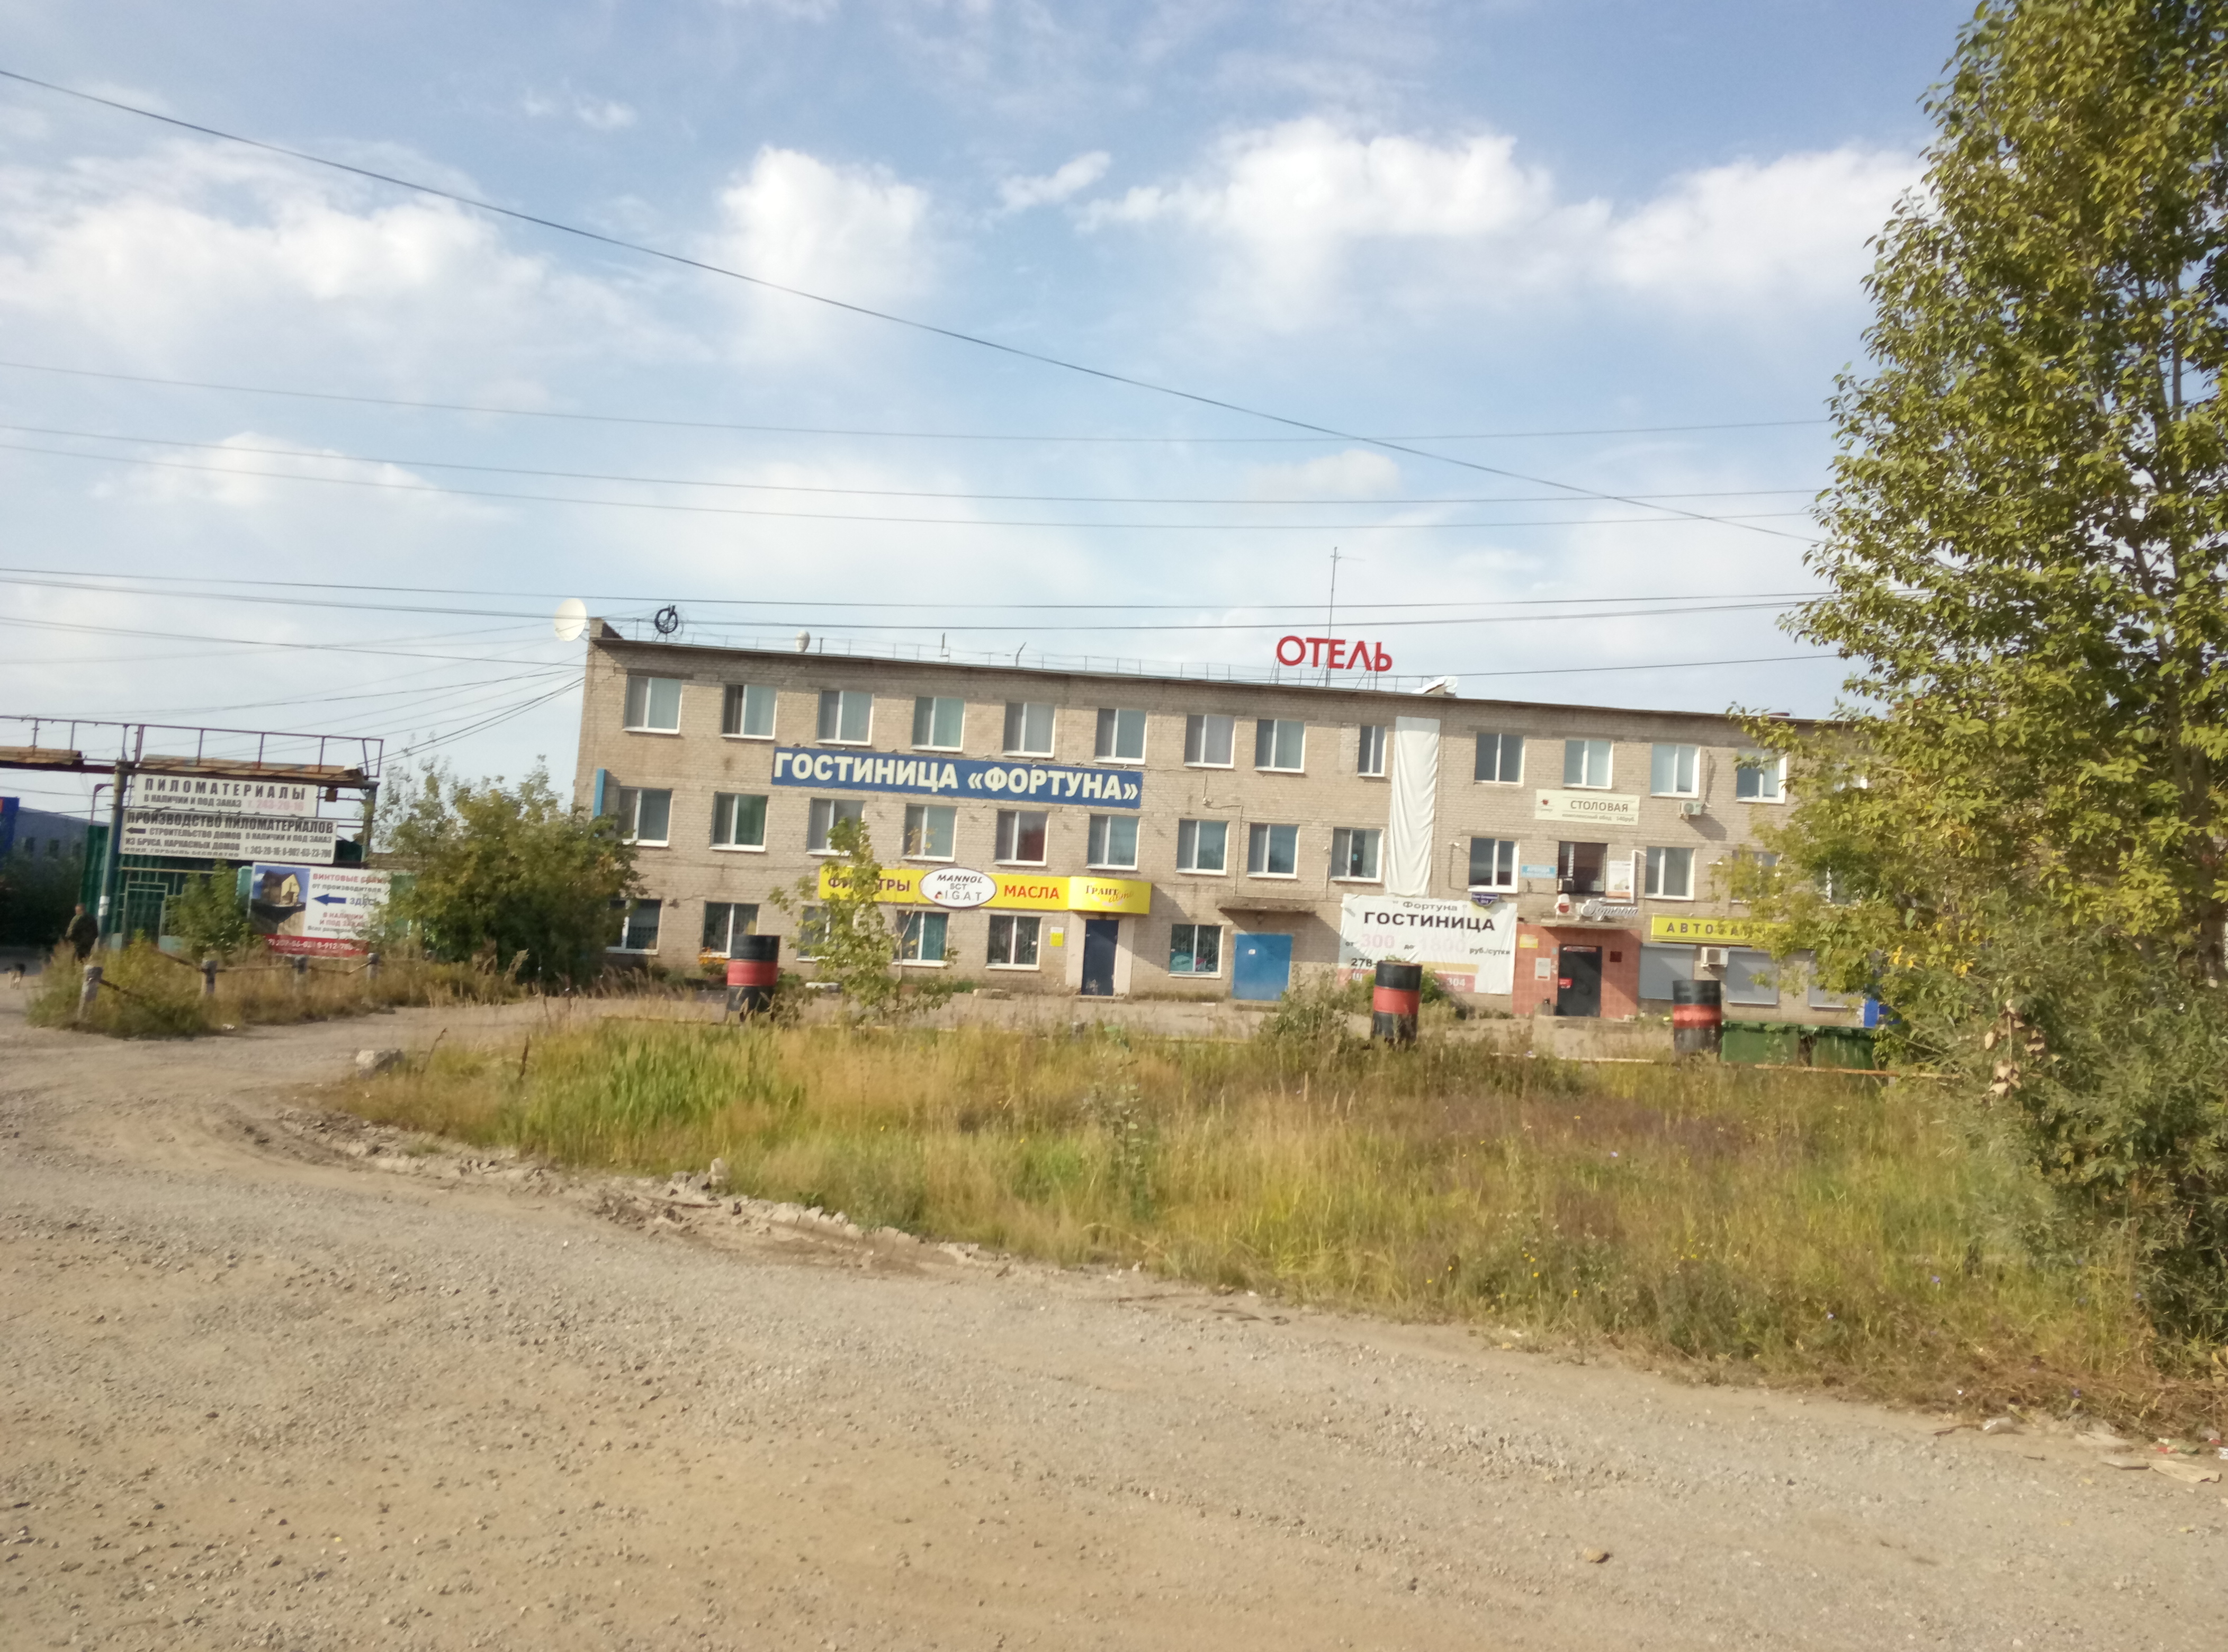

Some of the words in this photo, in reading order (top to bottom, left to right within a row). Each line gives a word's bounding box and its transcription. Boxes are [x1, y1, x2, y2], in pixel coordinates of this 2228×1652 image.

[1277, 635, 1393, 672] ОТЕЛЬ
[774, 752, 959, 792] ГОСТИНИЦА
[967, 767, 1138, 800] «ФОРТУНА»
[145, 778, 306, 800] ПИЛОМАТЕРИАЛЫ
[151, 794, 188, 804] НАЛИЧИИ
[197, 797, 214, 807] ПОД
[216, 798, 242, 808] ЗАКАЗ
[1570, 800, 1629, 812] СТОЛОВАЯ
[127, 812, 222, 828] ПРОИЗВОДСТВО
[224, 816, 333, 833] ПИЛОМАТЕРИАЛОВ
[149, 828, 212, 839] СТРОИТЕЛЬСТВО
[213, 831, 241, 840] ДОМОВ
[292, 834, 308, 843] ПОД
[212, 841, 240, 851] ДОМОВ
[312, 873, 358, 883] ВИНТОВЫЕ
[828, 876, 910, 892] ФИТРЫ
[937, 874, 983, 884] MANNOL
[1003, 885, 1059, 900] МАСЛА
[1363, 911, 1495, 933] ГОСТИНИЦА
[1361, 933, 1395, 949] 300
